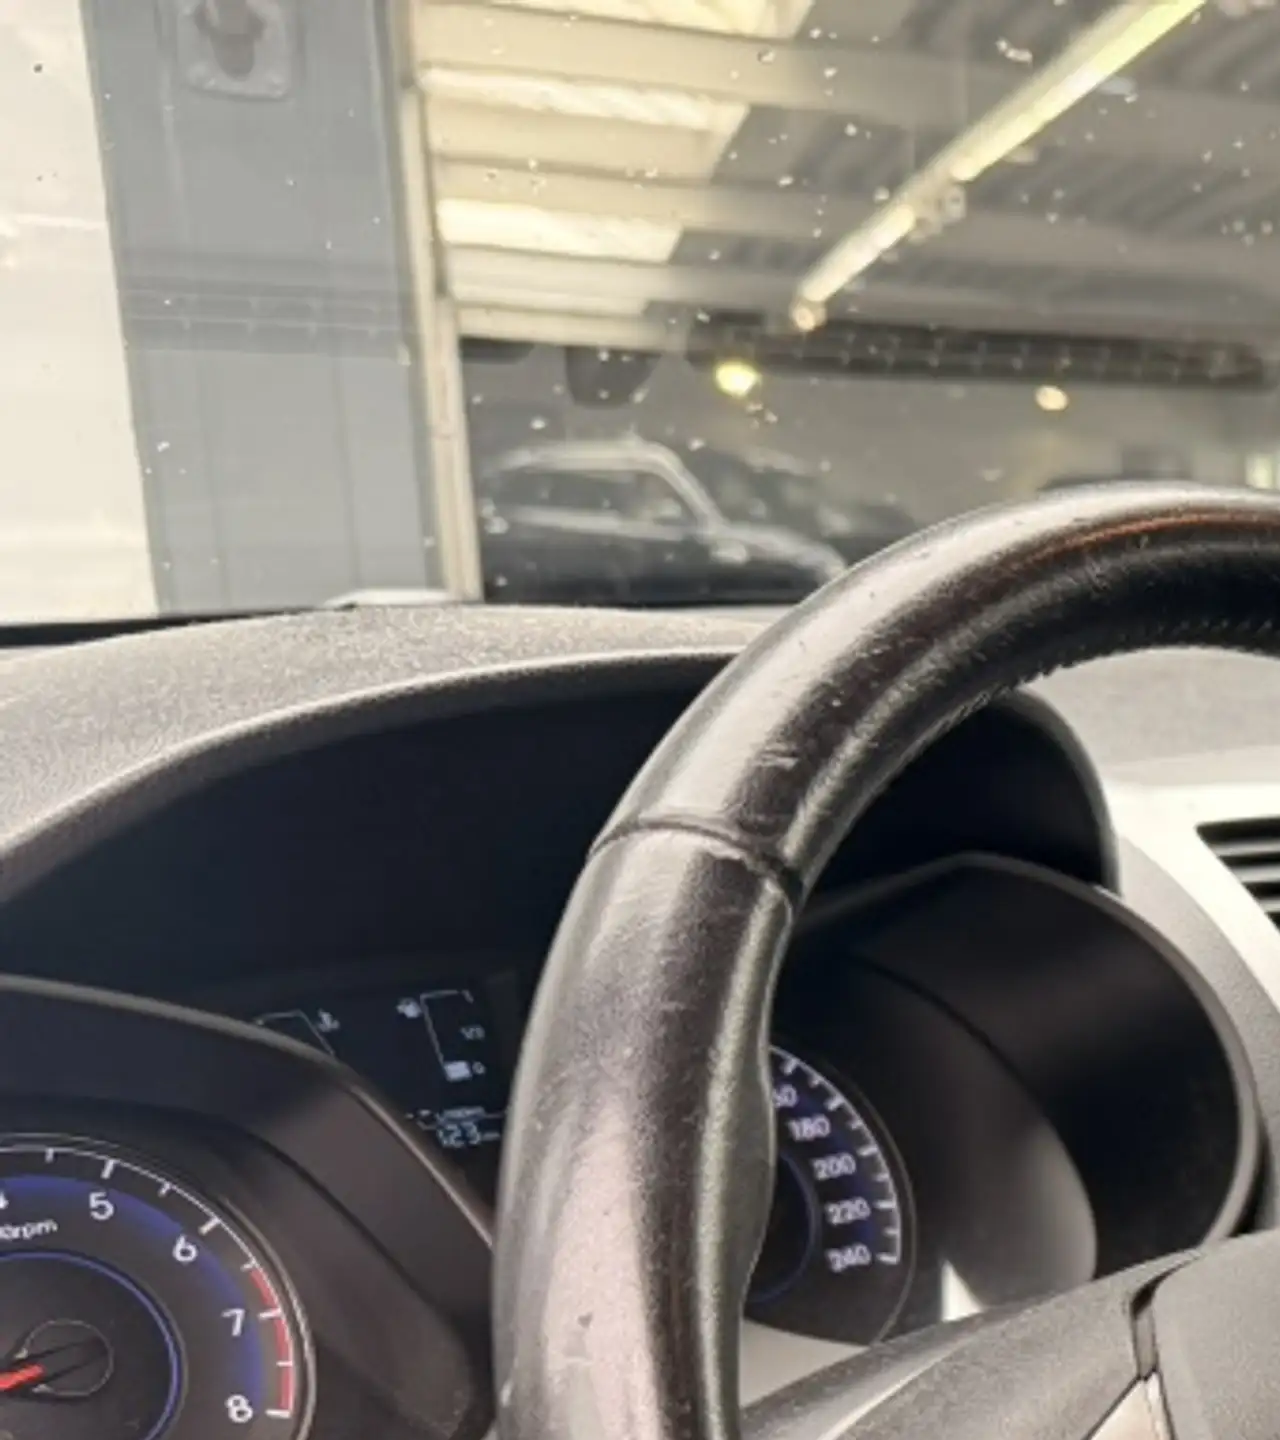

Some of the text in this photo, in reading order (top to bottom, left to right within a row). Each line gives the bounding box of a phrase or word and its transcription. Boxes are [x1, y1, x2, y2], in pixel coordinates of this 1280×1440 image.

[788, 1114, 831, 1141] 180
[812, 1152, 857, 1180] 200
[88, 1191, 115, 1221] 5
[826, 1197, 871, 1225] 220
[172, 1234, 199, 1263] 6
[827, 1244, 871, 1273] 240
[221, 1308, 245, 1336] 7
[225, 1394, 253, 1423] 8
